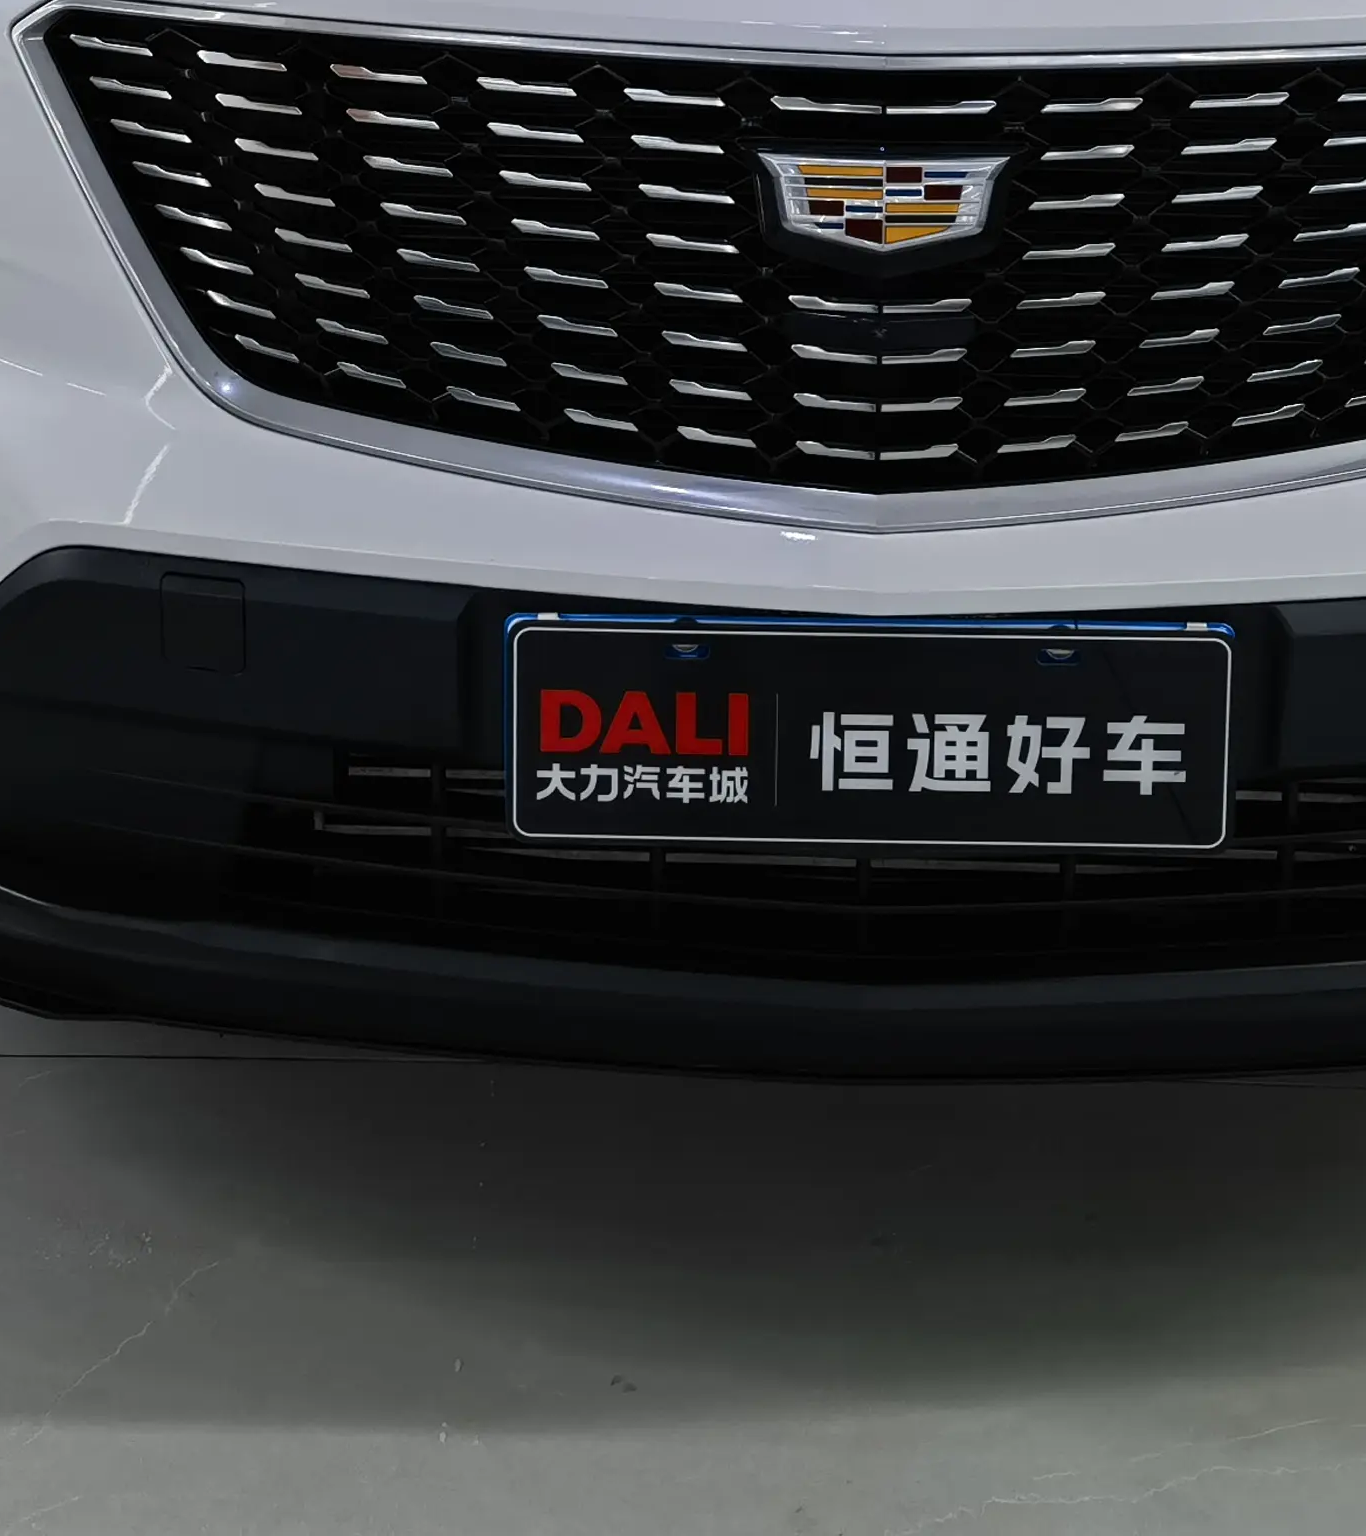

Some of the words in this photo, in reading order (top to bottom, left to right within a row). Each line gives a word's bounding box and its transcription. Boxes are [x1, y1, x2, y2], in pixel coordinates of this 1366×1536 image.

[540, 689, 749, 756] DALI
[810, 712, 1186, 795] 恒通好车
[536, 763, 749, 804] 大力汽车城
